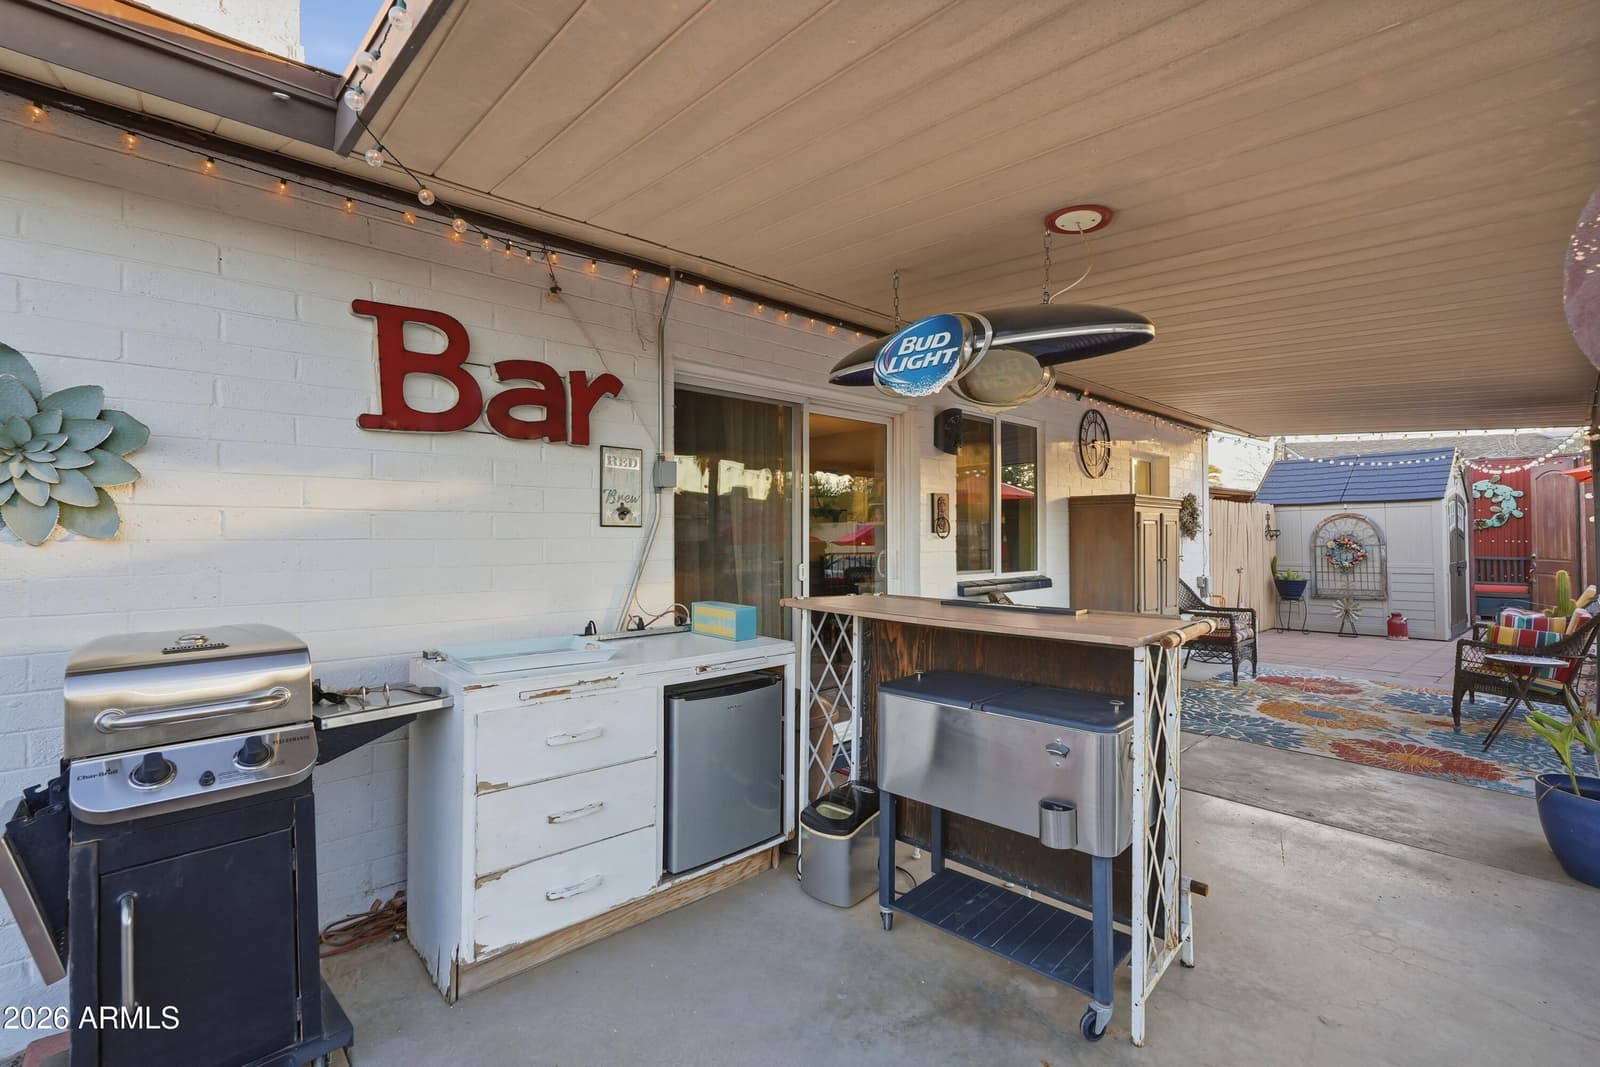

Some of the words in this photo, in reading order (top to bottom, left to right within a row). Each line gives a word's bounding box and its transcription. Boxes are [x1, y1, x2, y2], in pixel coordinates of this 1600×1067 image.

[898, 332, 951, 355] BUD
[350, 298, 624, 446] Bar
[886, 347, 959, 374] LIGHT
[606, 455, 638, 468] RED
[603, 489, 641, 504] Brew
